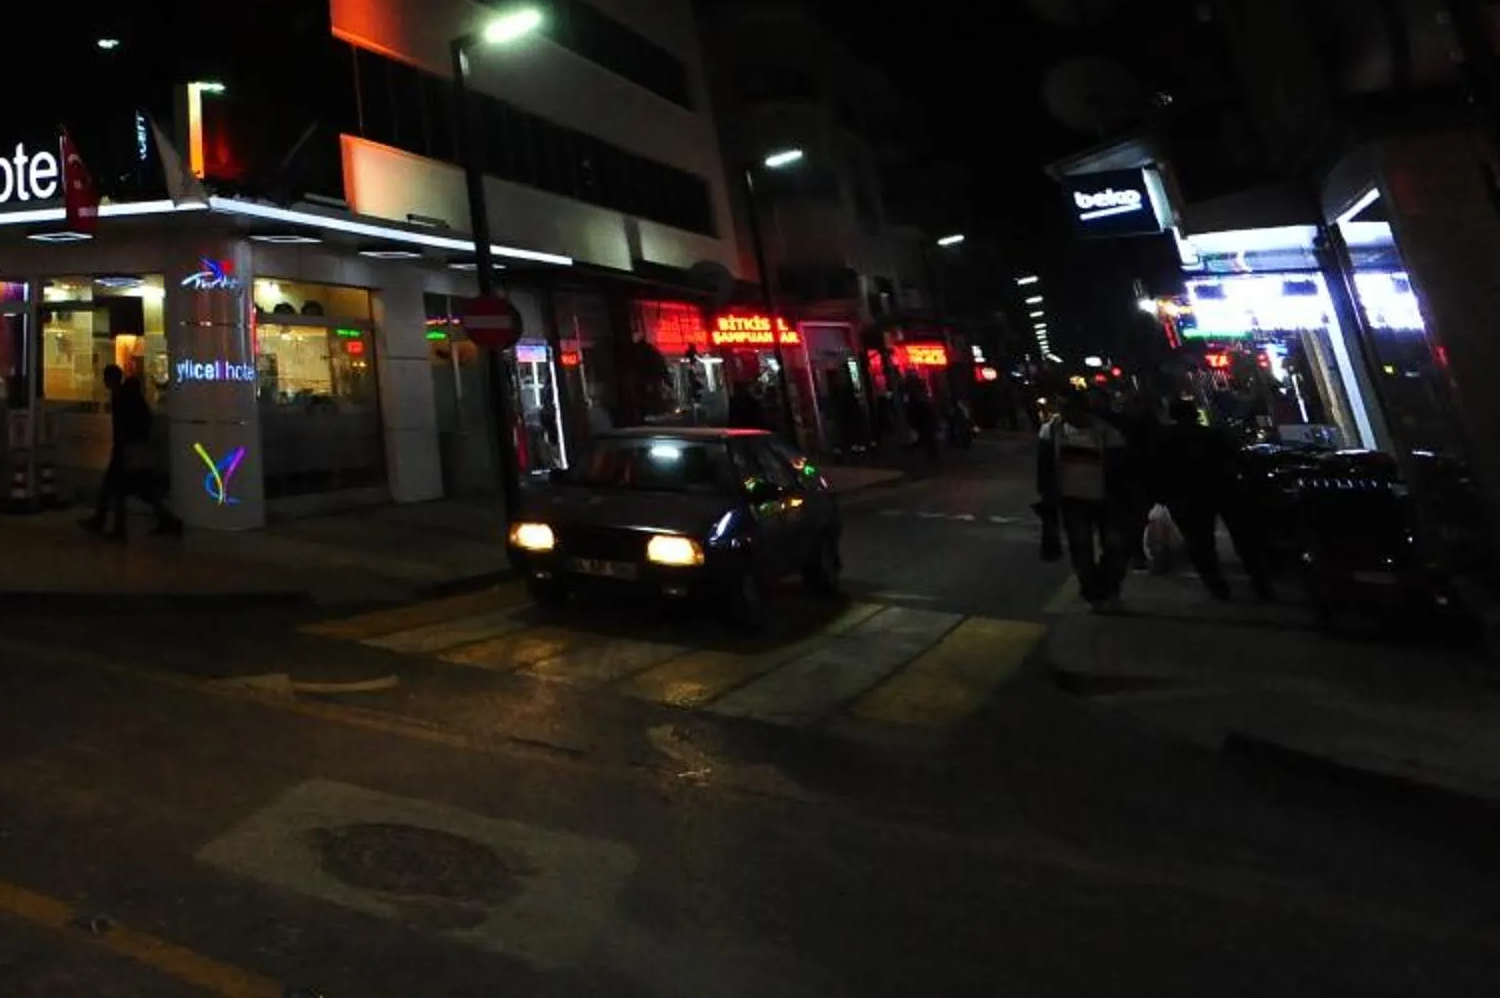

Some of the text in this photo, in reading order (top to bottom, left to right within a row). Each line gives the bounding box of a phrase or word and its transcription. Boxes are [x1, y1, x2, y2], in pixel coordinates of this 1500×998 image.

[1073, 188, 1141, 210] beko
[717, 314, 788, 330] BİTKİSL
[712, 331, 800, 344] ŞAMPUANAR
